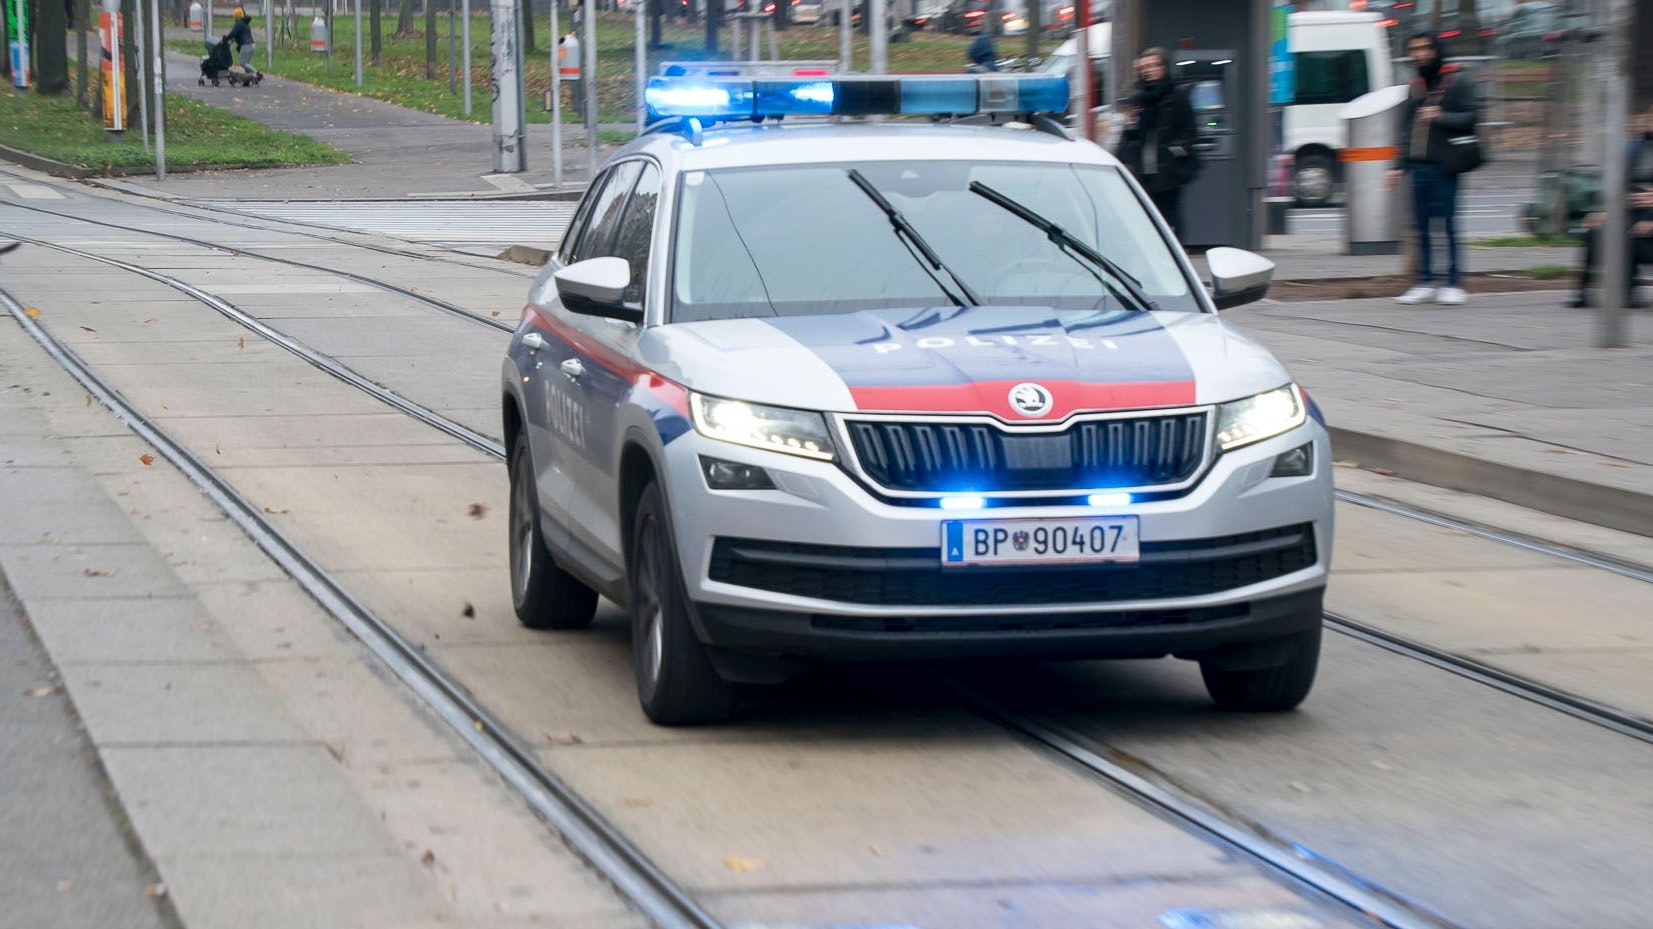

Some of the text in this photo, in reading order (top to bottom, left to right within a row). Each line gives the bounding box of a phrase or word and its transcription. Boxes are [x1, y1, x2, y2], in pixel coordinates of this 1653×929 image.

[872, 335, 1118, 354] POLIZEI
[544, 379, 586, 449] POLIZEI
[951, 547, 960, 556] A
[974, 525, 1124, 556] BP 90407
